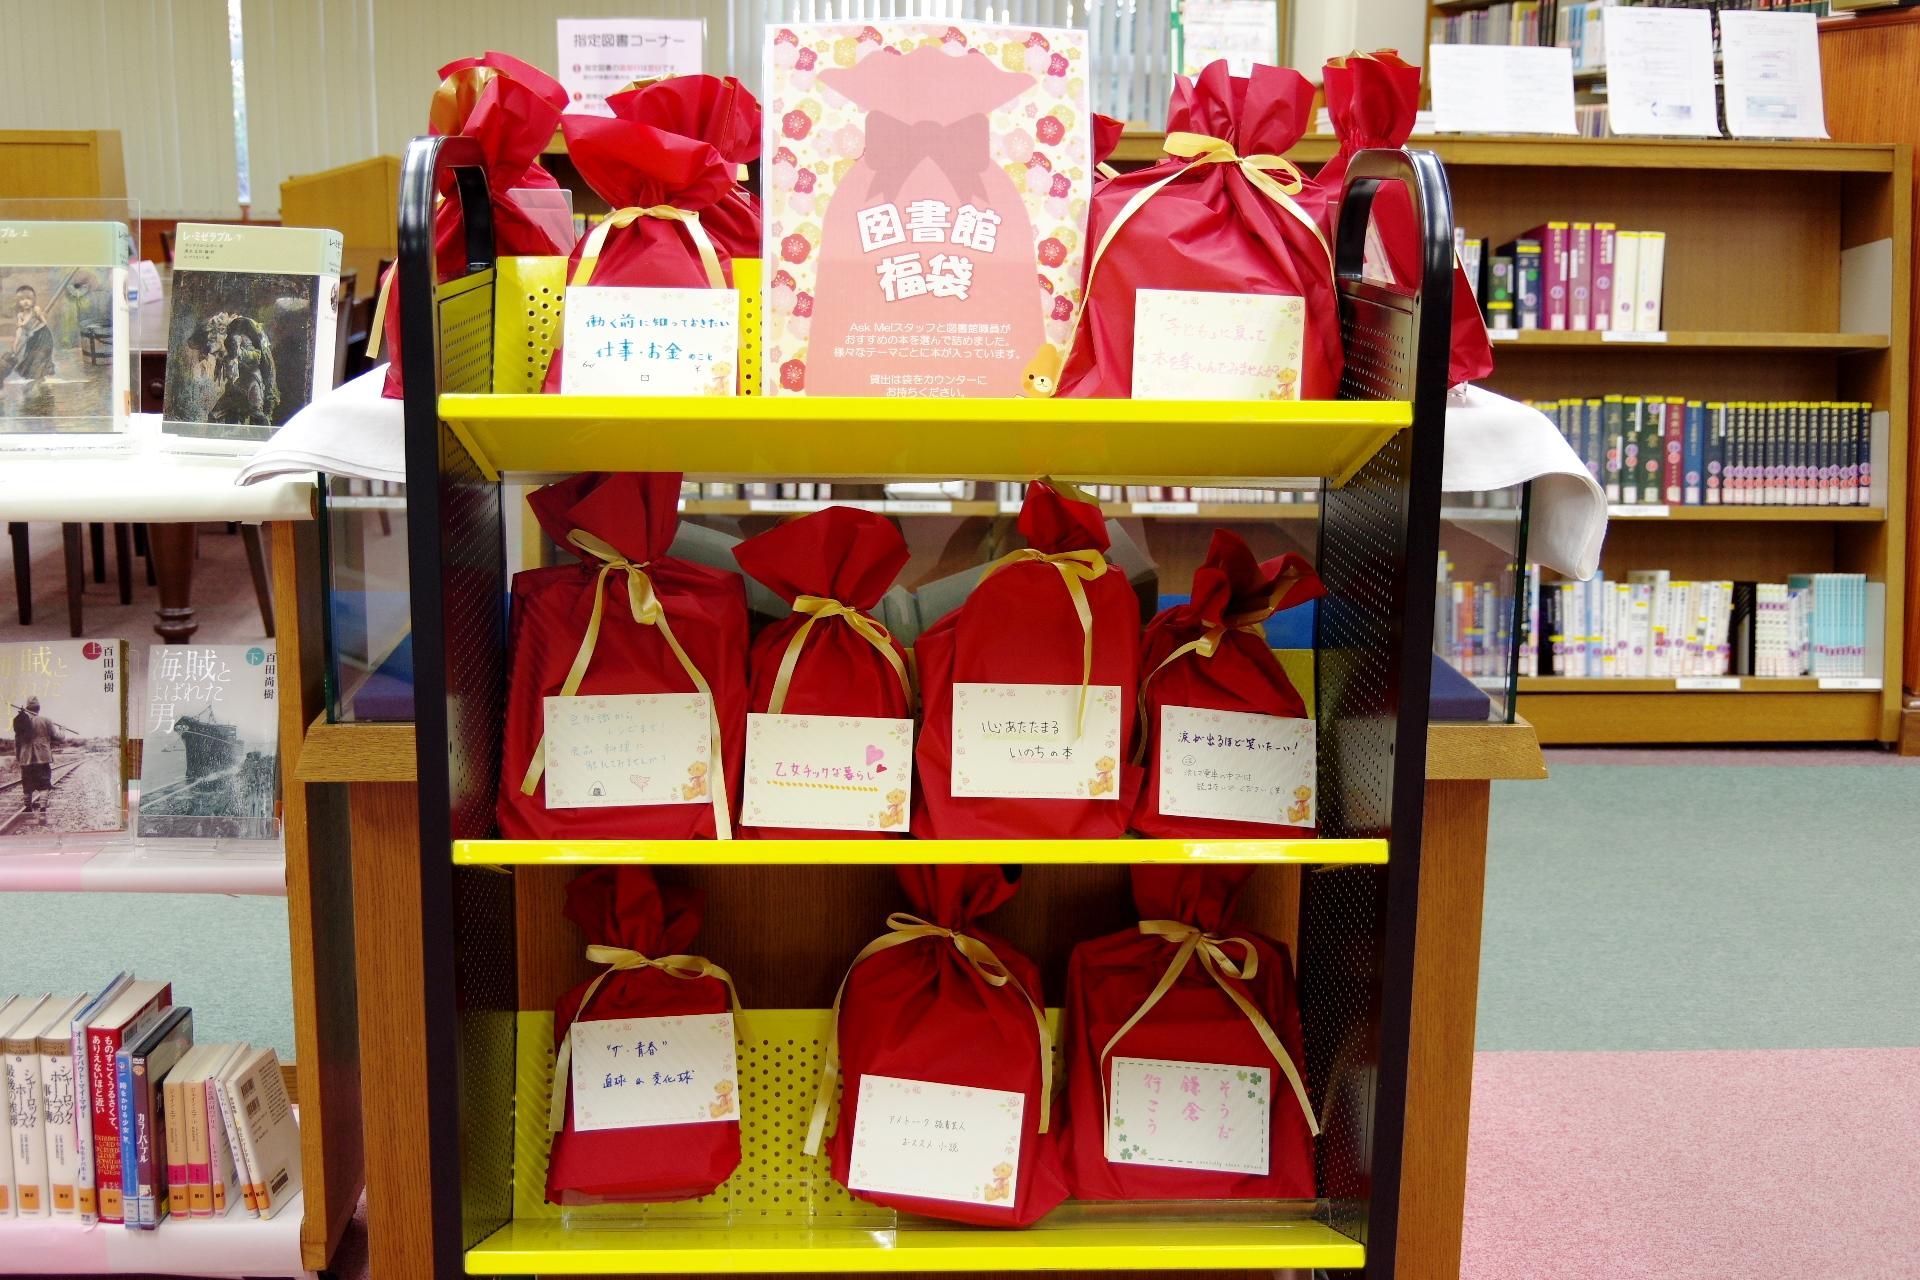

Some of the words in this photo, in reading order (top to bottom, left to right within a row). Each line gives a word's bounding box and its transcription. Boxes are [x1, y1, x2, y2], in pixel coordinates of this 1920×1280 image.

[573, 33, 685, 49] 指定図書コーナー
[856, 199, 1002, 252] 図書館
[876, 252, 974, 302] 福袋
[586, 313, 731, 329] 動く前に知っておきたい
[850, 323, 871, 332] Ask
[844, 335, 1010, 346] おすすめの本を選んで詰めました。
[834, 347, 1020, 360] 様々なテーマごとに本が入っています。
[870, 374, 987, 385] 貸出は袋をカウンターに
[886, 387, 965, 398] お持ちください。
[103, 645, 114, 693] 百田尚樹
[155, 648, 232, 682] 海賊と
[264, 652, 277, 700] 百田尚樹
[153, 682, 224, 702] よばれた
[150, 702, 175, 735] 男
[982, 720, 1060, 735] 心あたたまる
[1009, 745, 1073, 760] いのちの本
[775, 761, 876, 781] 乙女チックな暮らし
[93, 1035, 105, 1114] ありえないほど近い
[105, 1036, 119, 1131] ものすごくうるさくて、
[1143, 1073, 1162, 1136] 行こう
[136, 1113, 151, 1163] カラーパープル
